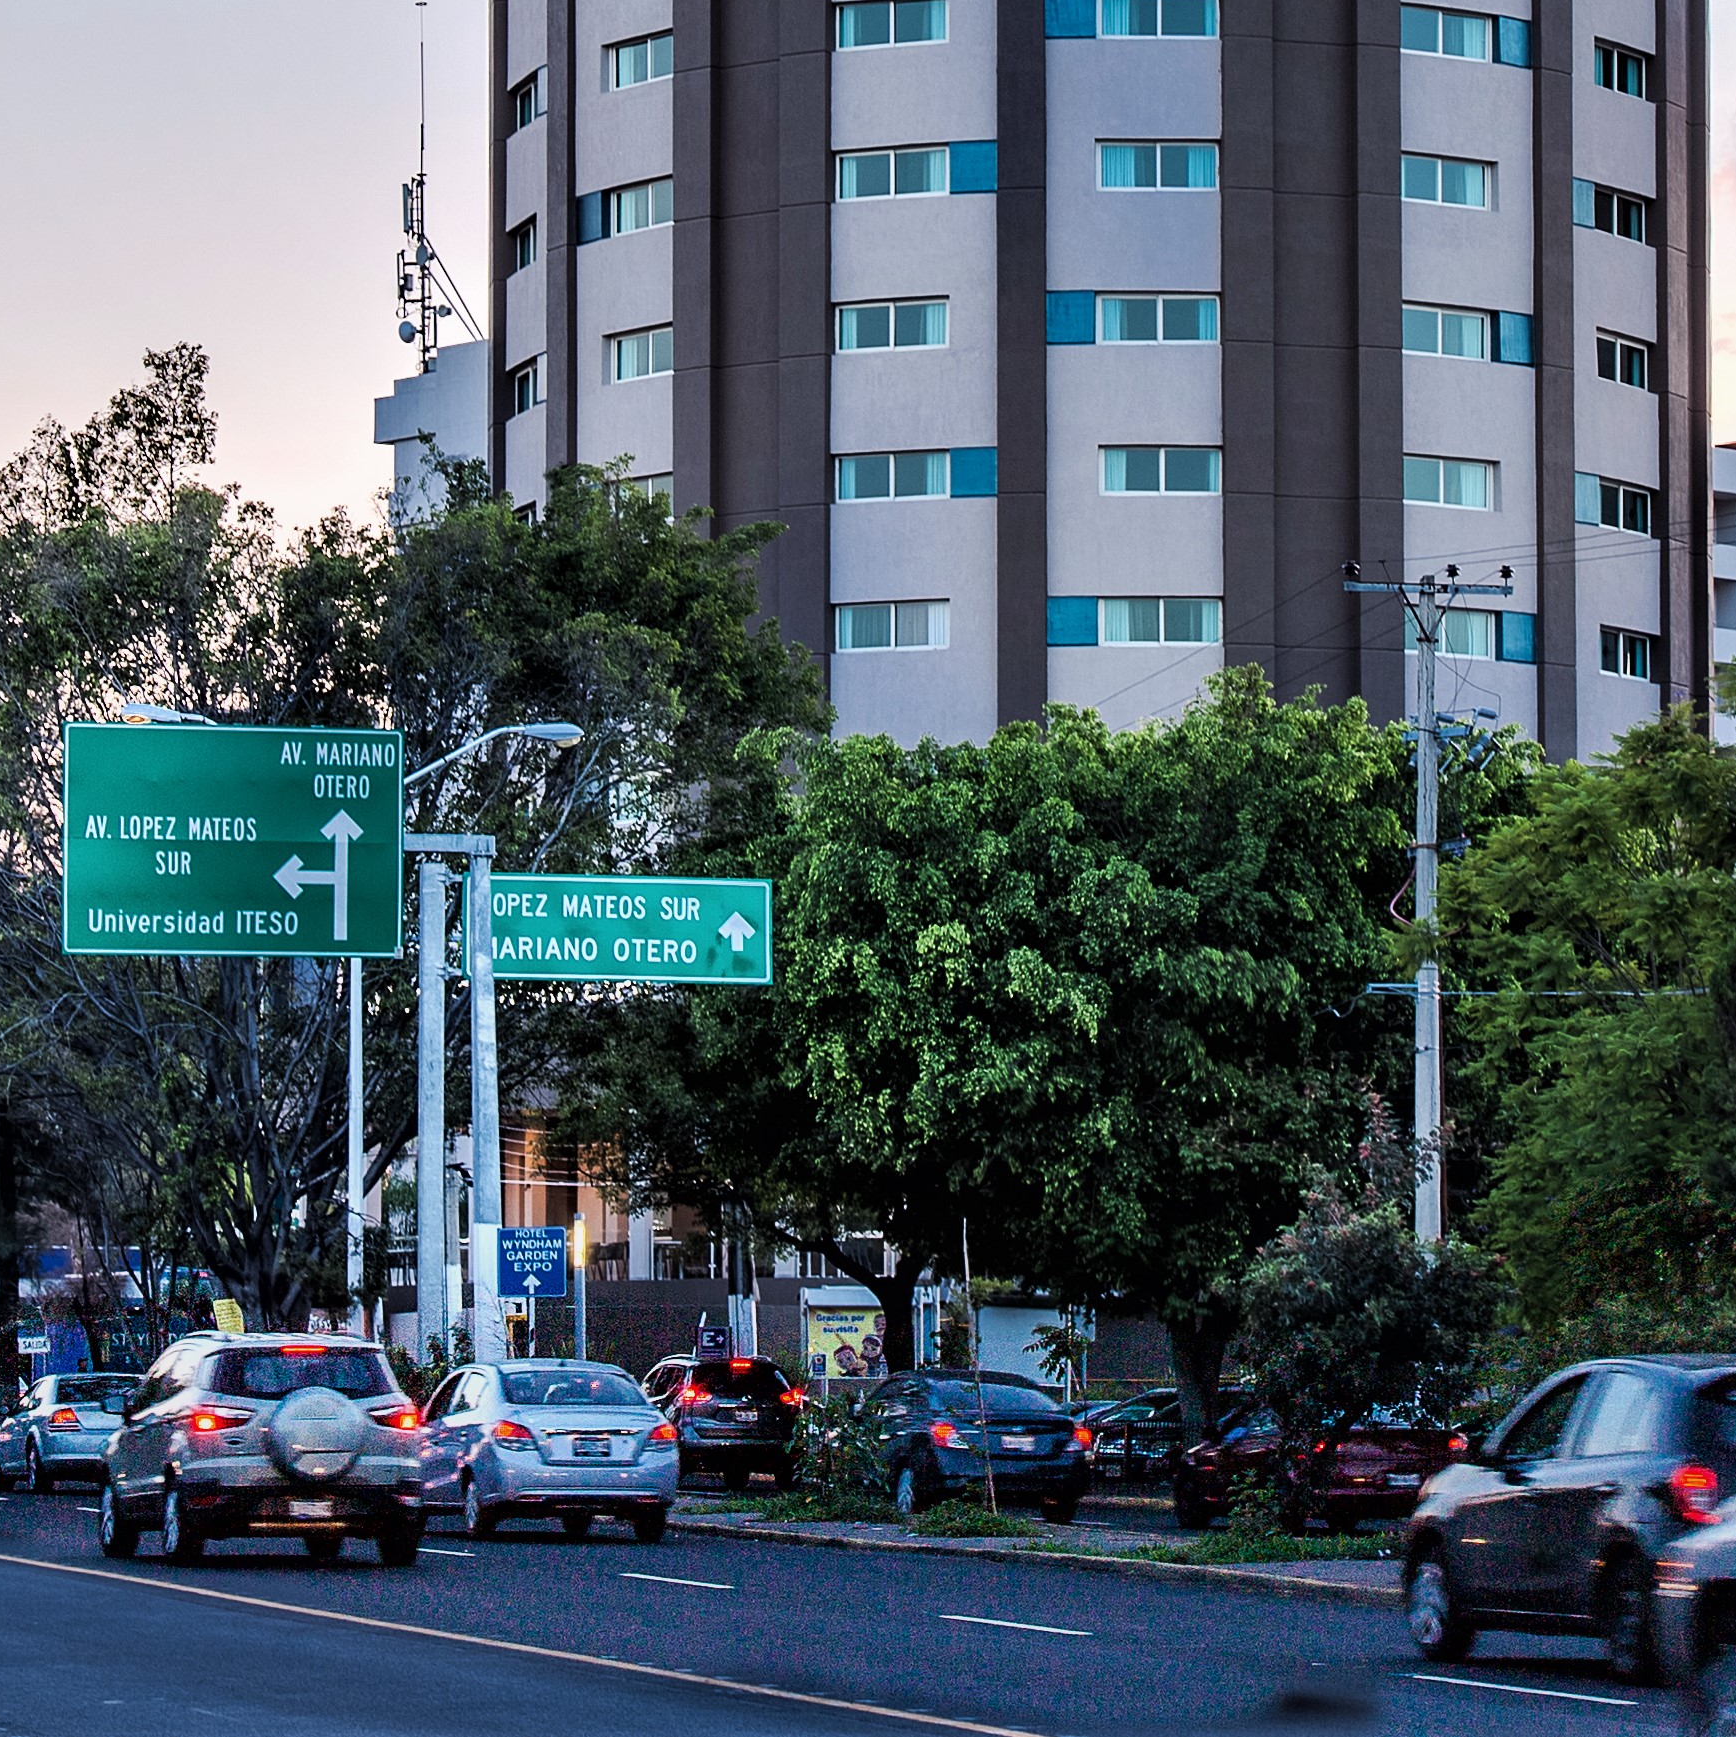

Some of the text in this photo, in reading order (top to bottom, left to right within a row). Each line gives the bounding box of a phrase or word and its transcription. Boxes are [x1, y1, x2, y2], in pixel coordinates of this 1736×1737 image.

[280, 741, 396, 767] AV. MARIANO
[314, 774, 370, 799] OTERO
[85, 815, 258, 842] AV. LOPEZ MATEOS
[154, 851, 192, 875] SUR
[492, 893, 701, 921] OPEZ MATEOS SUR
[88, 908, 299, 936] Universidad ITESO
[613, 938, 697, 964] OTERO
[502, 1239, 563, 1250] WYNDHAM
[515, 1229, 548, 1238] HOTEL
[506, 1250, 558, 1261] GARDEN
[513, 1261, 553, 1272] EXPO
[816, 1314, 849, 1322] Gracias
